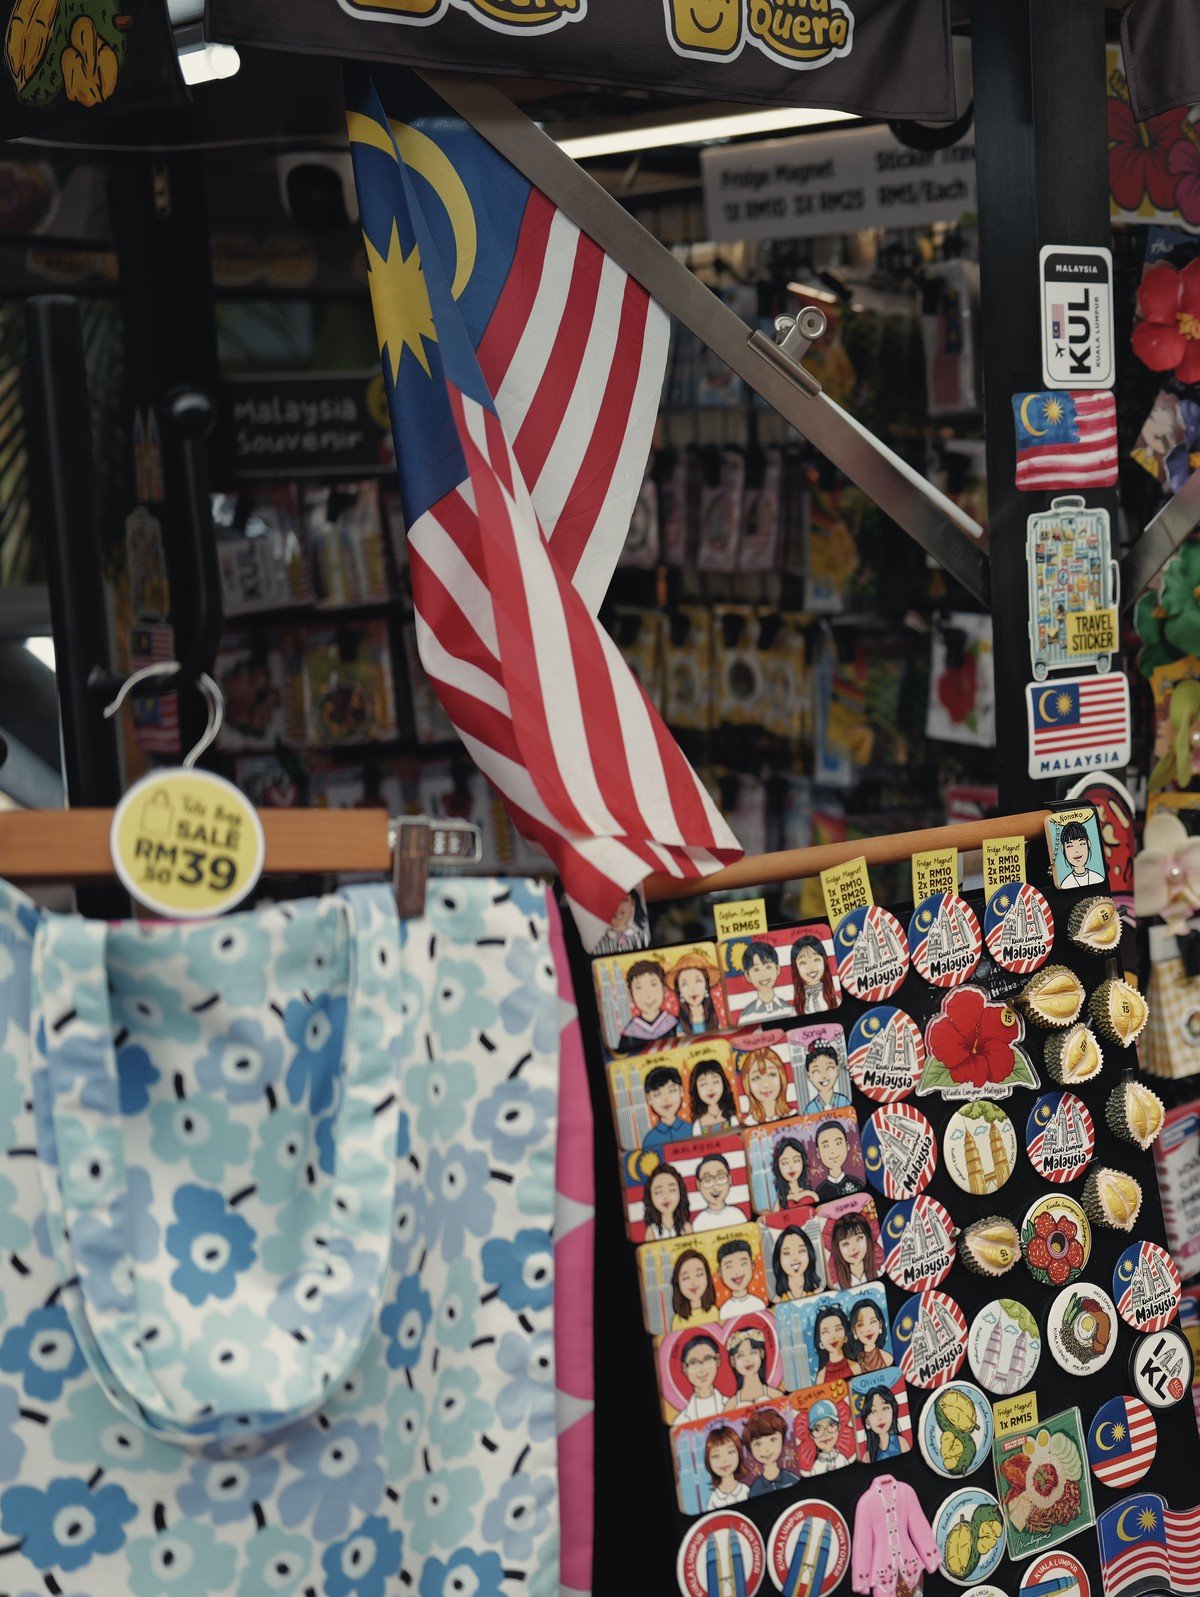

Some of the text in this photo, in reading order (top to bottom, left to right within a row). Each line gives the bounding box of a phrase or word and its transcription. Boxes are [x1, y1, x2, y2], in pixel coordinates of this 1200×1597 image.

[1055, 264, 1098, 274] MALAYSIA
[1068, 288, 1091, 374] KUL
[233, 395, 358, 427] Malaysia
[237, 429, 365, 456] Souvenir
[1075, 613, 1113, 634] TRAVEL
[1072, 632, 1114, 652] STICKER
[1040, 751, 1120, 773] MALAYSIA
[177, 821, 240, 852] SALE
[987, 842, 1020, 856] Fridge Magnet
[135, 837, 237, 891] RM 39
[916, 855, 952, 869] Fridge Magnet
[987, 854, 1019, 866] 1x RM10
[987, 864, 1021, 875] 2x RM20
[825, 866, 862, 886] Fridge Magnet
[917, 867, 951, 880] 1x RM10
[917, 876, 953, 890] 2x RM20
[988, 874, 1021, 885] 3x RM25
[828, 878, 862, 898] 1x RM10
[830, 887, 866, 908] 2x RM20
[918, 886, 953, 900] 3x RM25
[832, 897, 867, 917] 3x RM25
[1101, 912, 1109, 922] 15
[721, 919, 760, 934] 1x RM65
[1012, 934, 1043, 945] Kuala Lumpur
[938, 943, 970, 960] Kuala Lumpur
[1003, 943, 1046, 962] Malaysia
[865, 956, 899, 973] Kuala Lumpur
[930, 953, 975, 978] Malaysia
[857, 965, 903, 993] Malaysia
[1003, 1014, 1012, 1023] 15
[1122, 1005, 1130, 1014] 15
[891, 1064, 911, 1073] Lumpur
[864, 1071, 912, 1090] Malaysia
[902, 1132, 921, 1173] Kuala Lumpur
[1052, 1143, 1084, 1154] Kuala Lumpur
[903, 1136, 933, 1193] Malaysia
[1043, 1152, 1087, 1172] Malaysia
[1046, 1202, 1061, 1211] Kuala
[912, 1245, 945, 1264] Kuala Lumpur
[1000, 1248, 1009, 1257] 15
[903, 1254, 950, 1285] Malaysia
[1142, 1287, 1171, 1305] Kuala Lumpur
[1136, 1296, 1176, 1325] Malaysia
[925, 1335, 957, 1361] Kuala Lumpur
[1153, 1337, 1166, 1358] I
[919, 1343, 963, 1383] Malaysia
[860, 1374, 885, 1388] Olivia
[1140, 1357, 1168, 1400] KL
[997, 1399, 1033, 1418] Fridge Magnet
[1000, 1412, 1032, 1430] 1x RM15
[687, 1531, 705, 1568] LUMPUR
[739, 1522, 761, 1575] TWIN TOWER
[774, 1510, 805, 1572] KUALA LUMPUR
[832, 1521, 847, 1577] TWIN TOWER
[1034, 1558, 1080, 1579] KUALA LUMPUR
